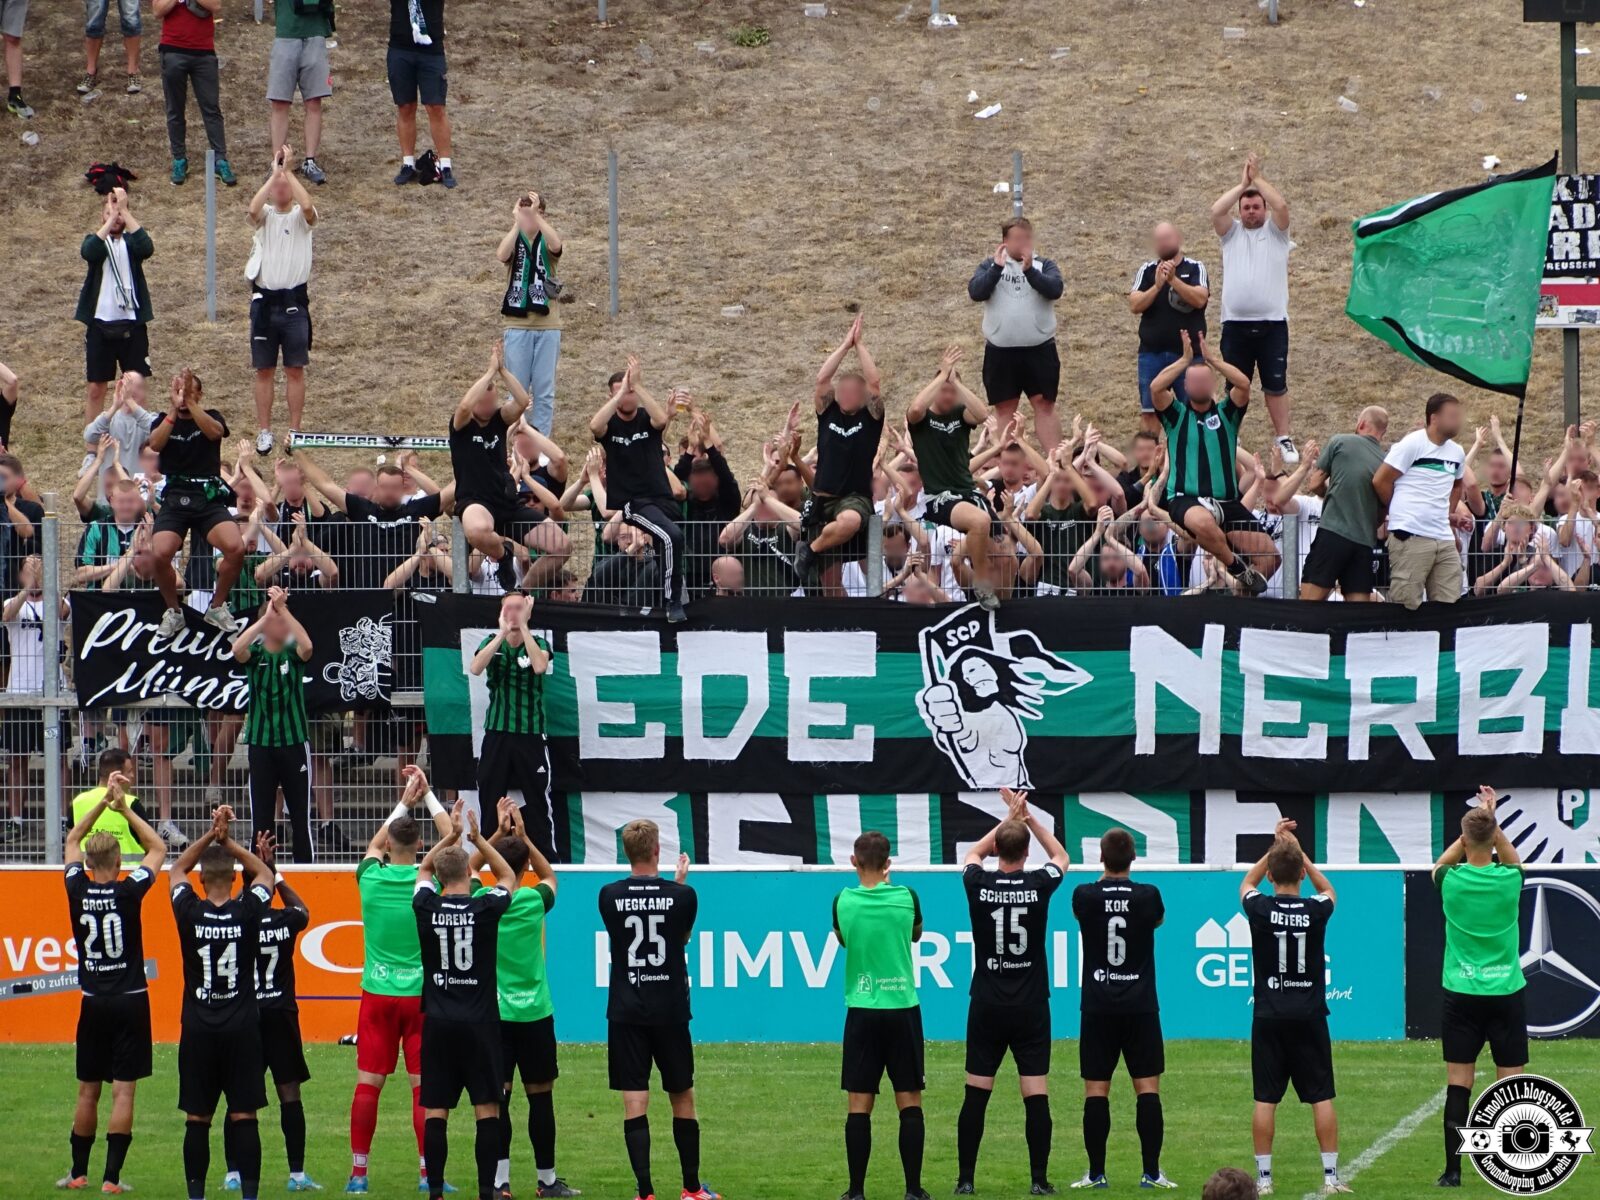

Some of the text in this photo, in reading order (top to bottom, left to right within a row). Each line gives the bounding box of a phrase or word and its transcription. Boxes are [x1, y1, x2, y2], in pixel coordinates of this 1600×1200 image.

[1545, 261, 1596, 271] REUSSEN
[945, 620, 981, 647] SCP
[1562, 789, 1585, 821] P
[979, 888, 1039, 904] SCHERDER
[82, 898, 117, 911] GROTE
[615, 897, 674, 912] WEGKAMP
[1105, 899, 1130, 913] KOK
[431, 912, 475, 926] LORENZ
[1270, 911, 1310, 928] DETERS
[79, 912, 124, 959] 20
[194, 925, 242, 939] WOOTEN
[990, 906, 1028, 956] 15
[433, 925, 474, 971] 18
[624, 914, 666, 967] 25
[1107, 915, 1127, 967] 6
[1273, 930, 1307, 974] 11
[196, 941, 239, 989] 14
[253, 945, 279, 991] 7
[1002, 961, 1032, 969] Gieseke
[448, 977, 478, 985] Gieseke
[640, 973, 670, 982] Gieseke
[1109, 972, 1140, 981] Gieseke
